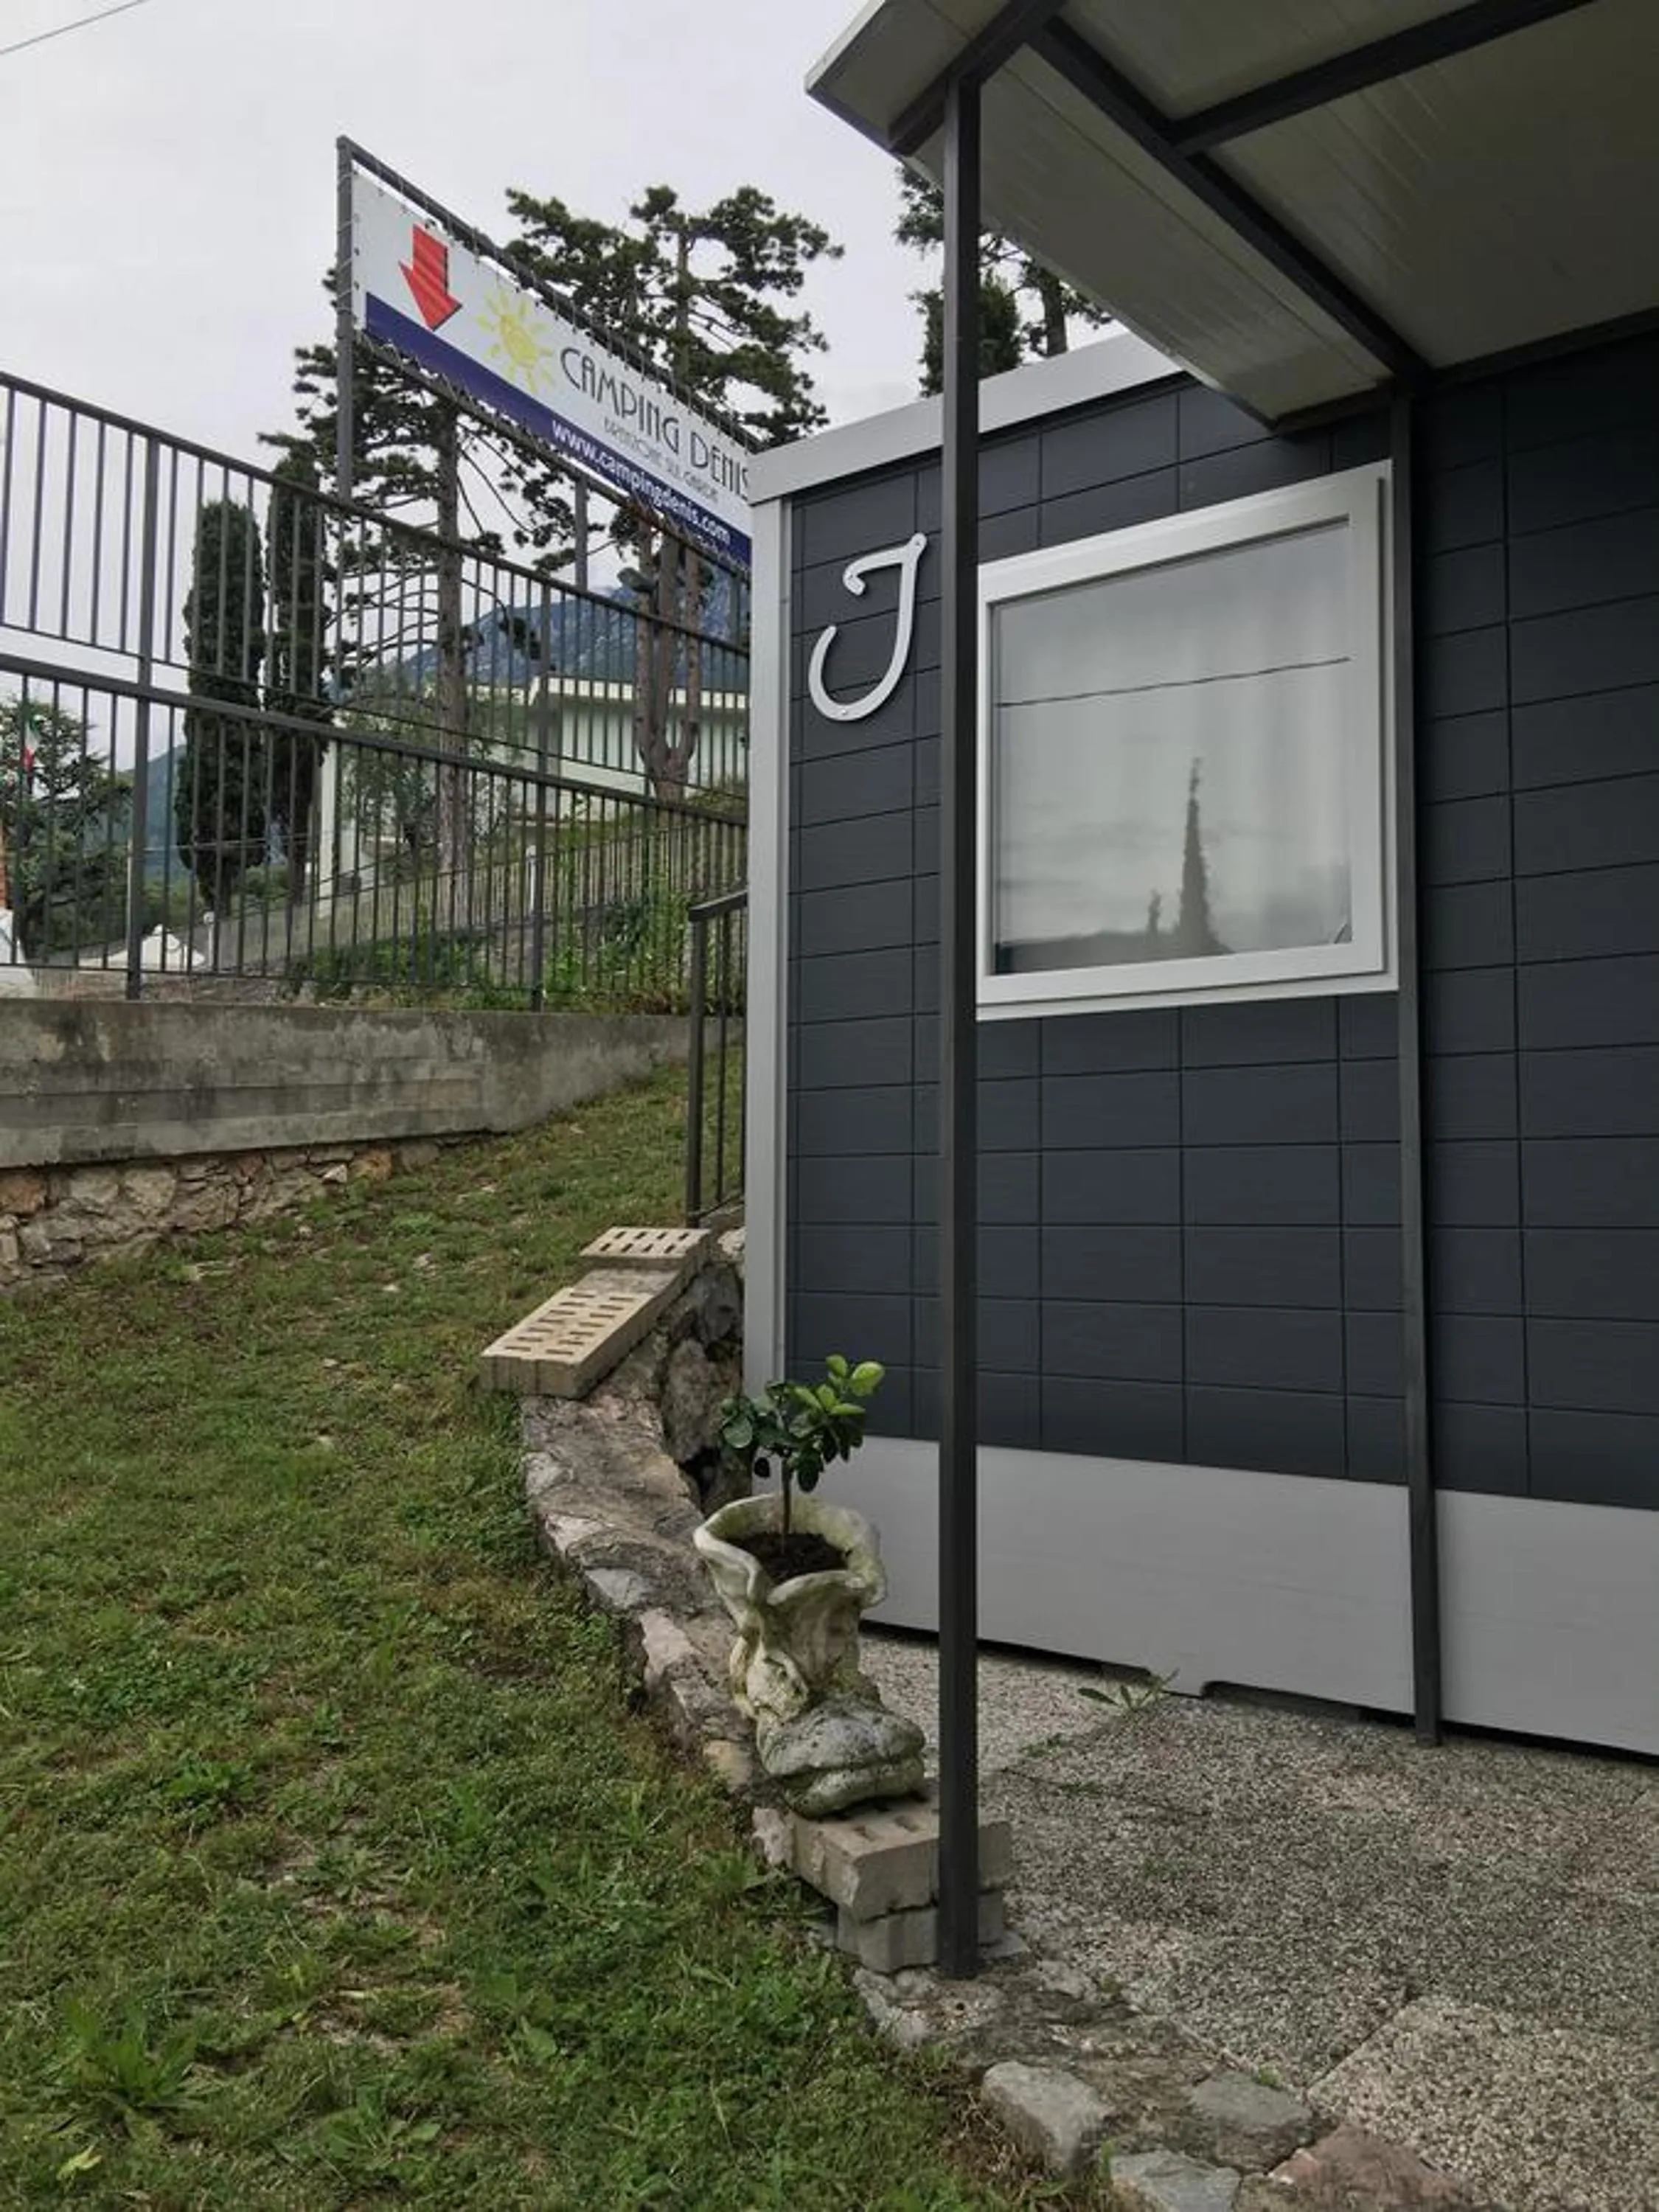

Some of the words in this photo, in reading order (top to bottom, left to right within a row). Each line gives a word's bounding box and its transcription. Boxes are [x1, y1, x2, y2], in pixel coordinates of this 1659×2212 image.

[560, 347, 680, 455] CAMPING
[552, 420, 731, 546] www.campingdenis.com
[808, 532, 927, 722] J
